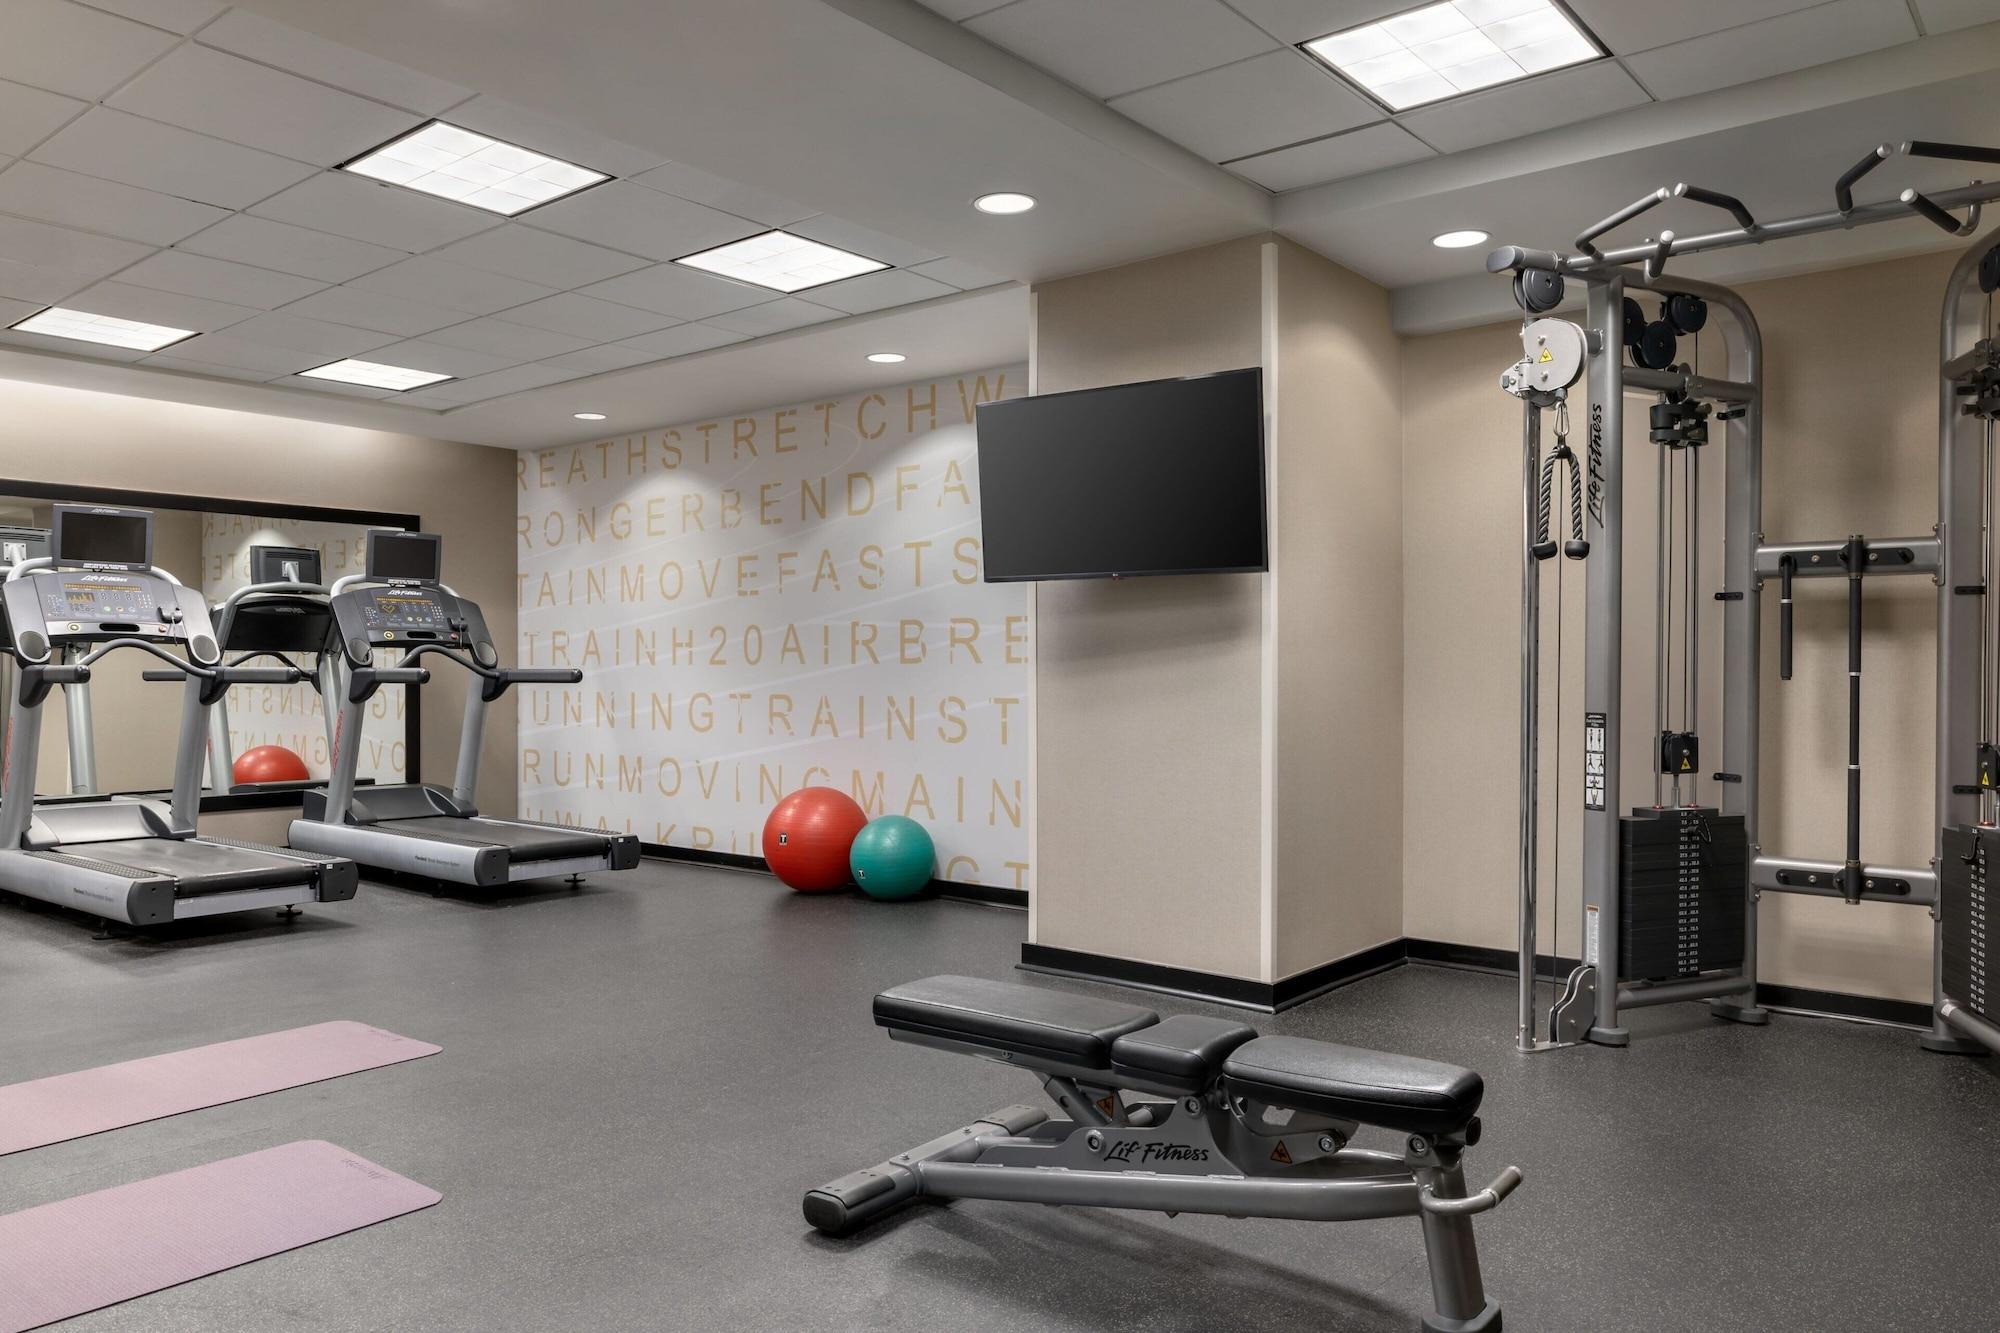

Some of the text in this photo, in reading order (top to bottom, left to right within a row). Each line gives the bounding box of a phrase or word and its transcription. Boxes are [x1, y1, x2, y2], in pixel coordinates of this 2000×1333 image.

[1588, 403, 1605, 481] Fitness
[517, 690, 1020, 745] UNNINGTRAINST
[1141, 1142, 1209, 1164] Fitness
